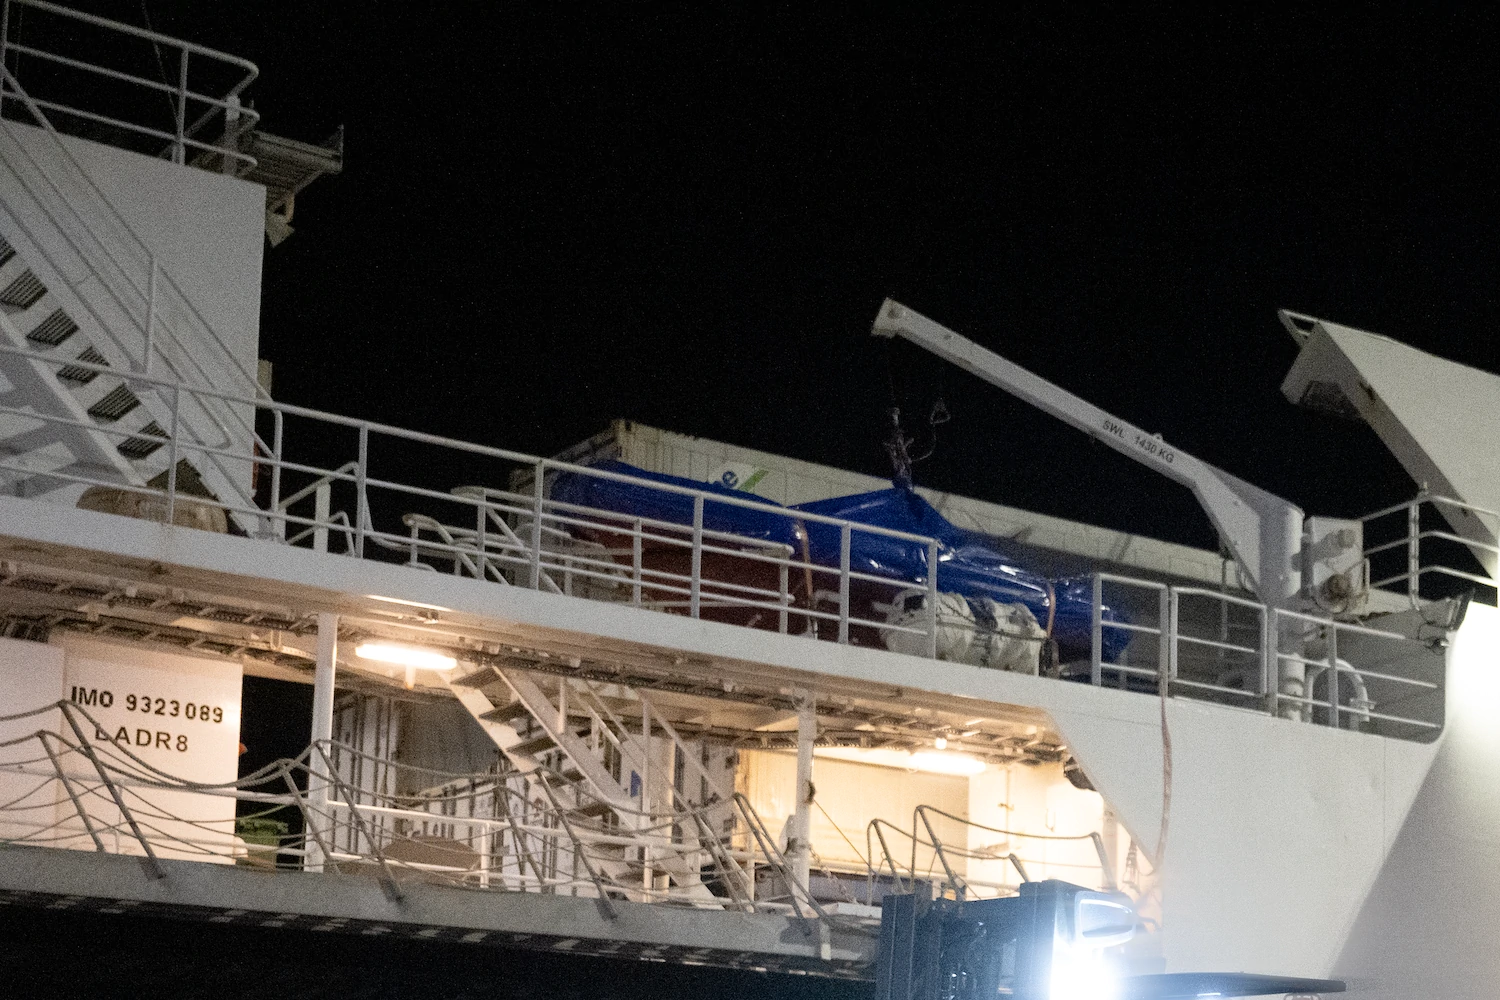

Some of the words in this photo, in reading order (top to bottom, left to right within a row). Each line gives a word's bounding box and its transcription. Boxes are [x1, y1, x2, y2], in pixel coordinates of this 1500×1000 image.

[1158, 448, 1174, 463] KG
[71, 686, 114, 708] IMO
[126, 694, 223, 723] 9323089
